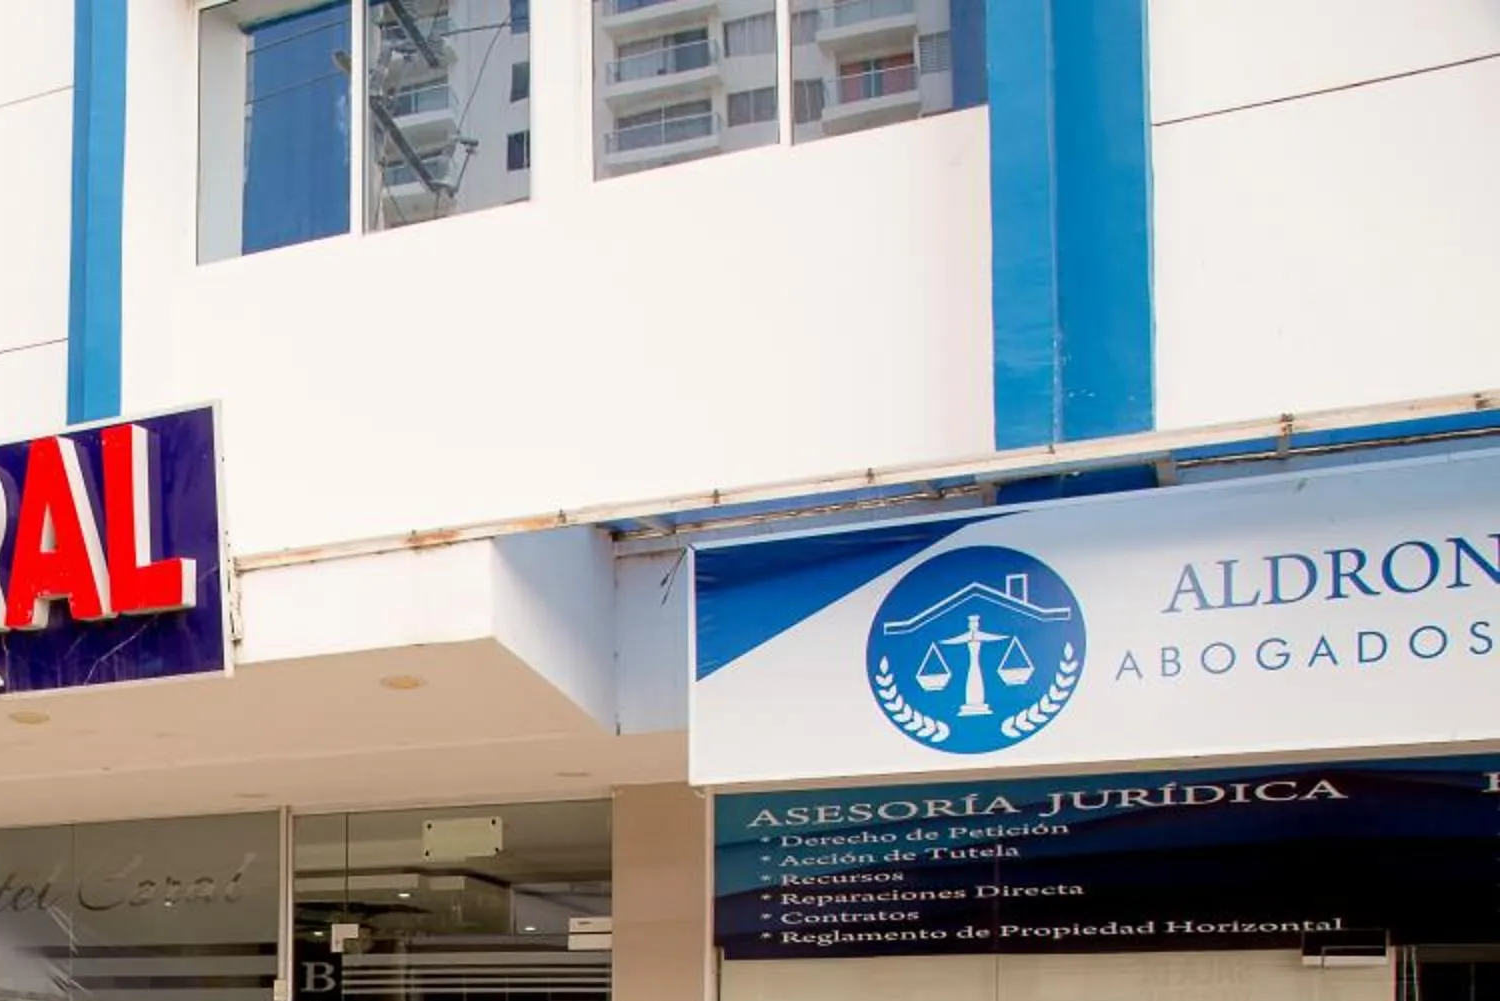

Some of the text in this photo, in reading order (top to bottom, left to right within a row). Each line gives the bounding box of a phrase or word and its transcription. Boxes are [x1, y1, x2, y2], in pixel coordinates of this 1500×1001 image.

[1160, 532, 1500, 614] ALDRON
[1115, 620, 1493, 681] ABOGADOS
[746, 780, 1349, 828] ASESORÍA JURÍDICA
[779, 821, 1071, 848] Derecho de Petición
[778, 844, 1021, 868] Acción de Tutela
[780, 869, 905, 887] Recursos
[780, 883, 1086, 908] Reparaciones Directa
[780, 909, 921, 926] Contratos
[780, 918, 1345, 948] Reglamento de Propiedad Horizontal
